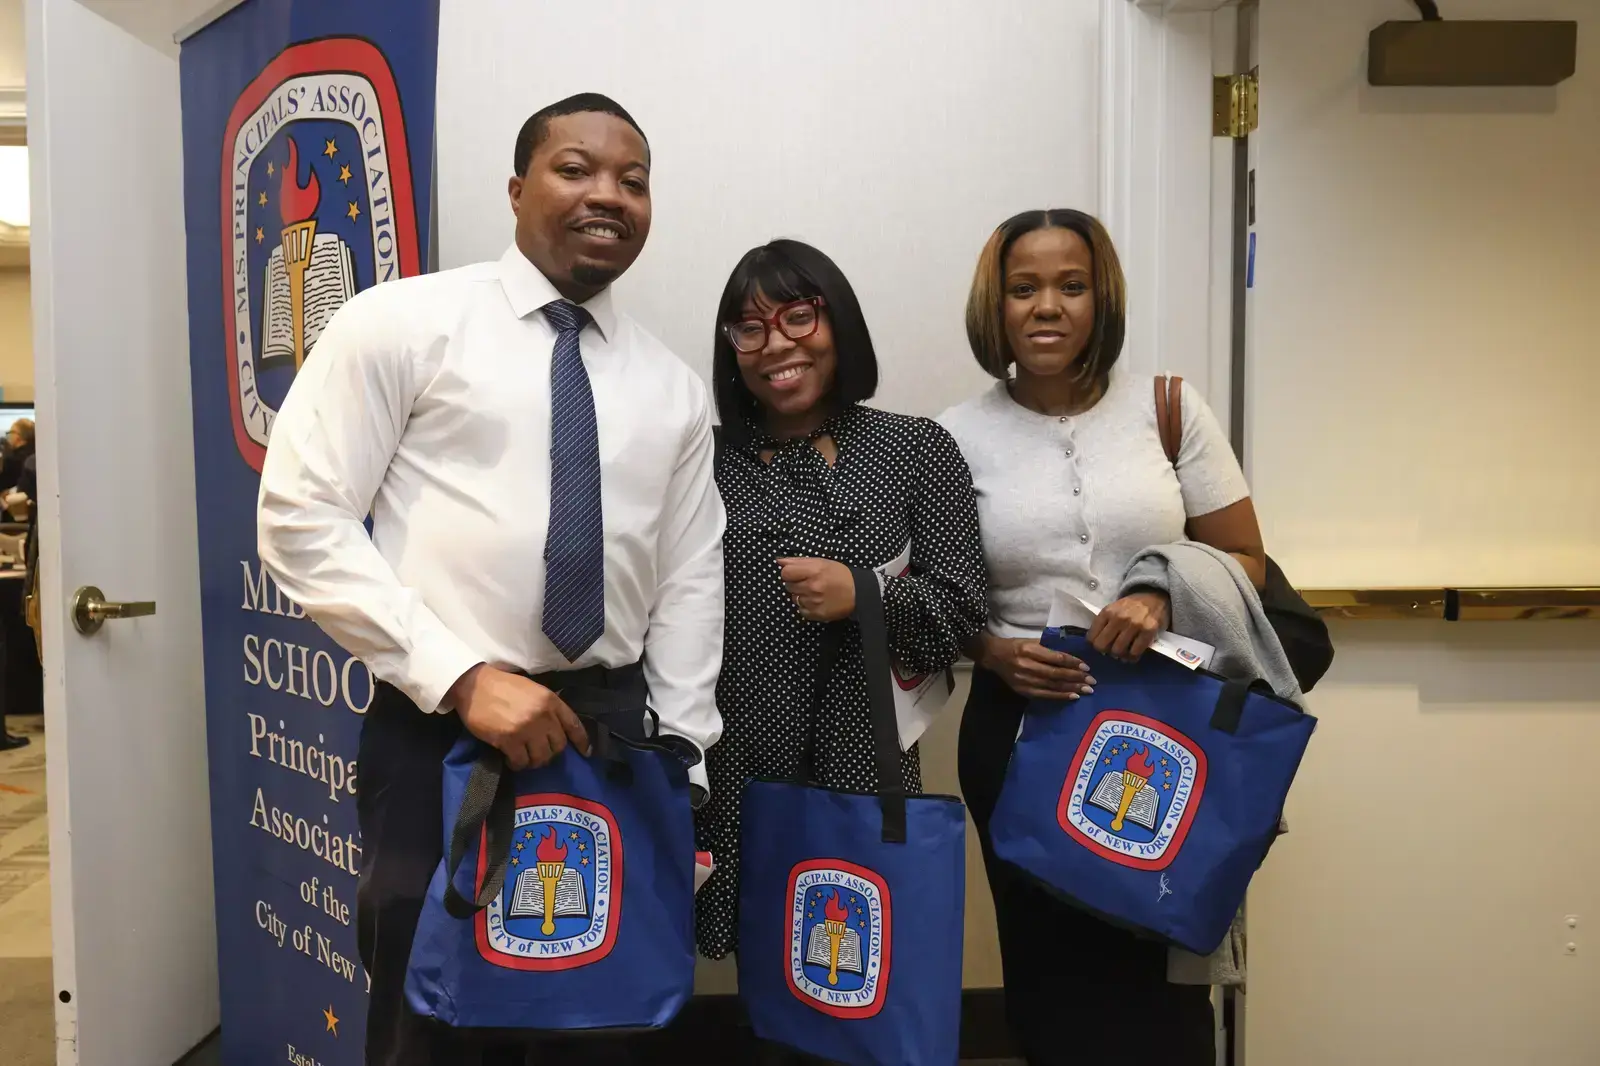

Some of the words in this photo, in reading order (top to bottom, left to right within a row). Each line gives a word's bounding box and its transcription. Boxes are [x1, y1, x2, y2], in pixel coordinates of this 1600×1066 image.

[235, 86, 306, 240] PRINCIPALS'
[310, 85, 396, 283] ASSOCIATION
[236, 250, 248, 314] M.S.
[241, 360, 273, 438] CITY
[243, 634, 375, 714] SCHOO
[247, 712, 357, 802] Principa
[1079, 760, 1094, 781] M.S.
[1090, 724, 1161, 756] PRINCIPALS'
[1160, 741, 1193, 820] ASSOCIATION
[564, 809, 609, 894] ASSOCIATION
[1071, 795, 1088, 826] CITY
[1087, 825, 1102, 838] of
[1103, 835, 1134, 852] NEW
[1138, 832, 1170, 855] YORK
[300, 876, 319, 908] of
[322, 885, 350, 926] the
[793, 917, 802, 942] M.S.
[795, 872, 843, 913] PRINCIPALS'
[845, 875, 880, 957] ASSOCIATION
[255, 900, 288, 948] City
[292, 925, 312, 956] of
[315, 931, 357, 983] New
[490, 913, 516, 949] CITY
[518, 941, 533, 954] of
[539, 941, 574, 954] NEW
[578, 912, 606, 948] YORK
[793, 957, 810, 989] CITY
[812, 987, 823, 998] of
[827, 991, 852, 1003] NEW
[854, 974, 876, 1002] YORK
